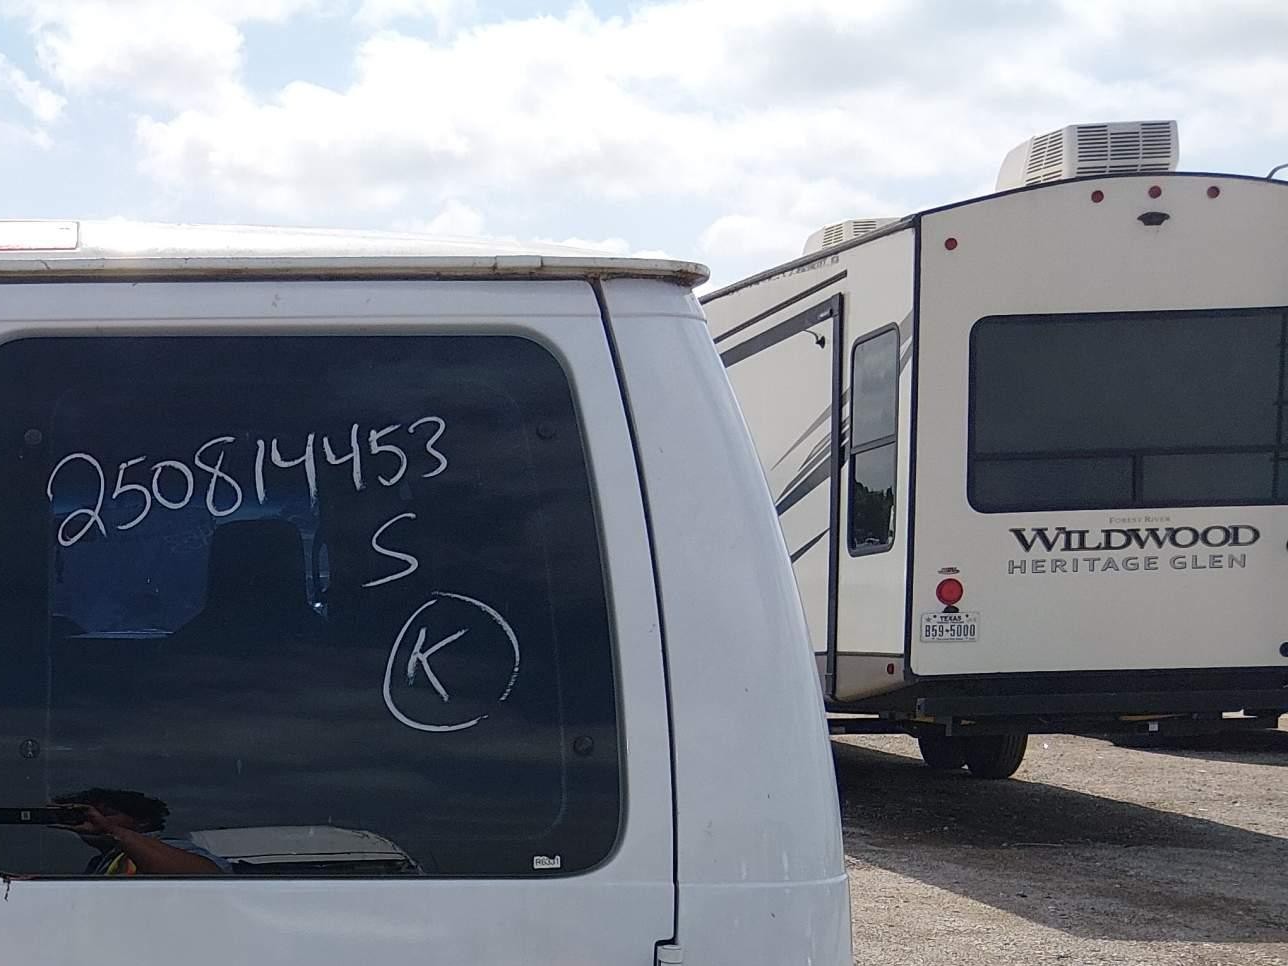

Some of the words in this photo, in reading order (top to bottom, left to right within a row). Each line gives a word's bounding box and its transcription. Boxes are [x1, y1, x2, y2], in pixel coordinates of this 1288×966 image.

[47, 416, 449, 547] 250814453
[1008, 557, 1159, 574] HERITAGE
[1169, 554, 1247, 570] GLEN
[1009, 525, 1261, 552] WILDWOOD
[406, 627, 469, 702] K
